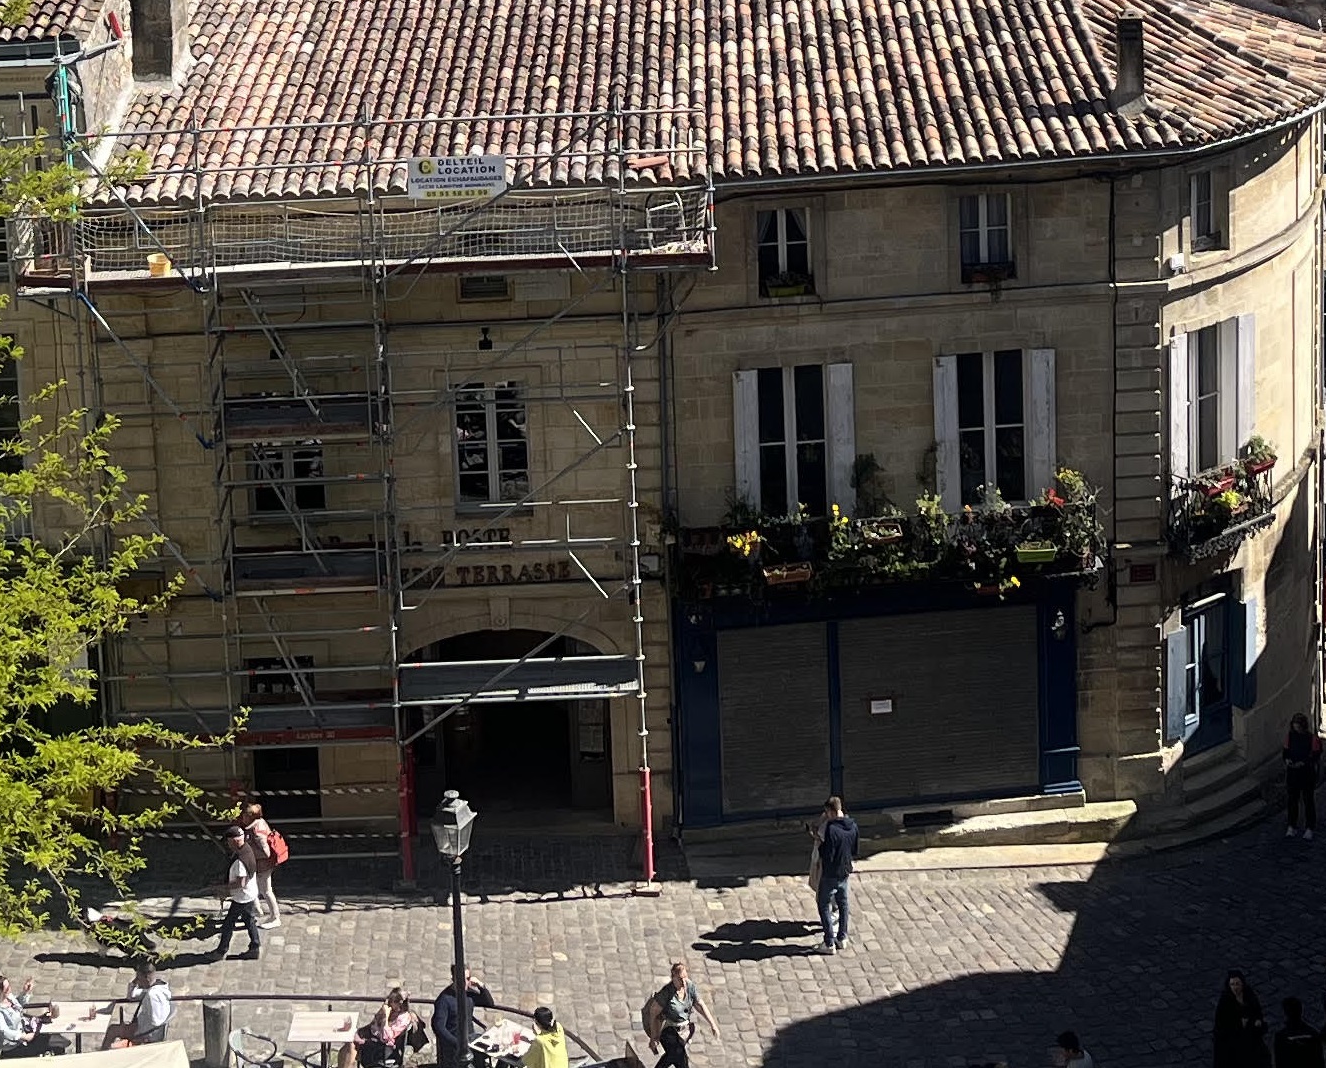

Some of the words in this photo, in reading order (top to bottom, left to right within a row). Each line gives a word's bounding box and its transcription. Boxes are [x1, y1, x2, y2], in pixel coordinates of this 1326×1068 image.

[437, 158, 484, 166] DELTEIL
[438, 165, 496, 175] LOCATION
[456, 562, 571, 584] TERRASSE
